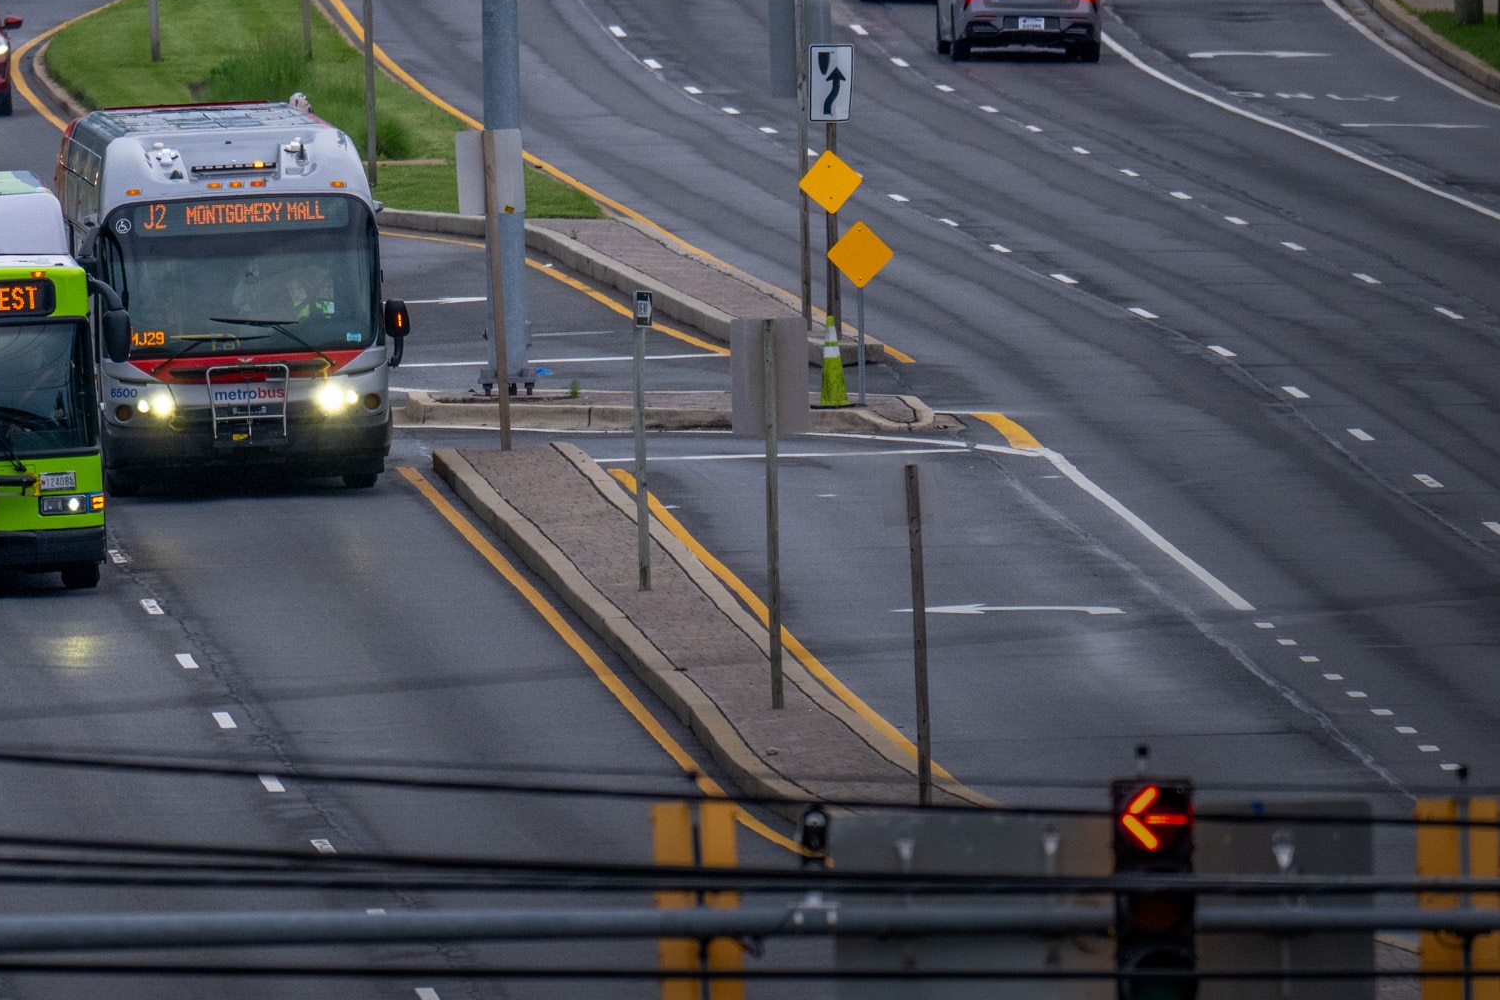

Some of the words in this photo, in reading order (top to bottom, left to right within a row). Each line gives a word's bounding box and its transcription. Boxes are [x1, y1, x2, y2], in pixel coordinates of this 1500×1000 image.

[143, 203, 167, 230] J2
[186, 201, 283, 226] MONTGOMERY
[287, 200, 325, 221] MALL
[110, 387, 138, 399] 6500
[214, 386, 286, 402] metrobus
